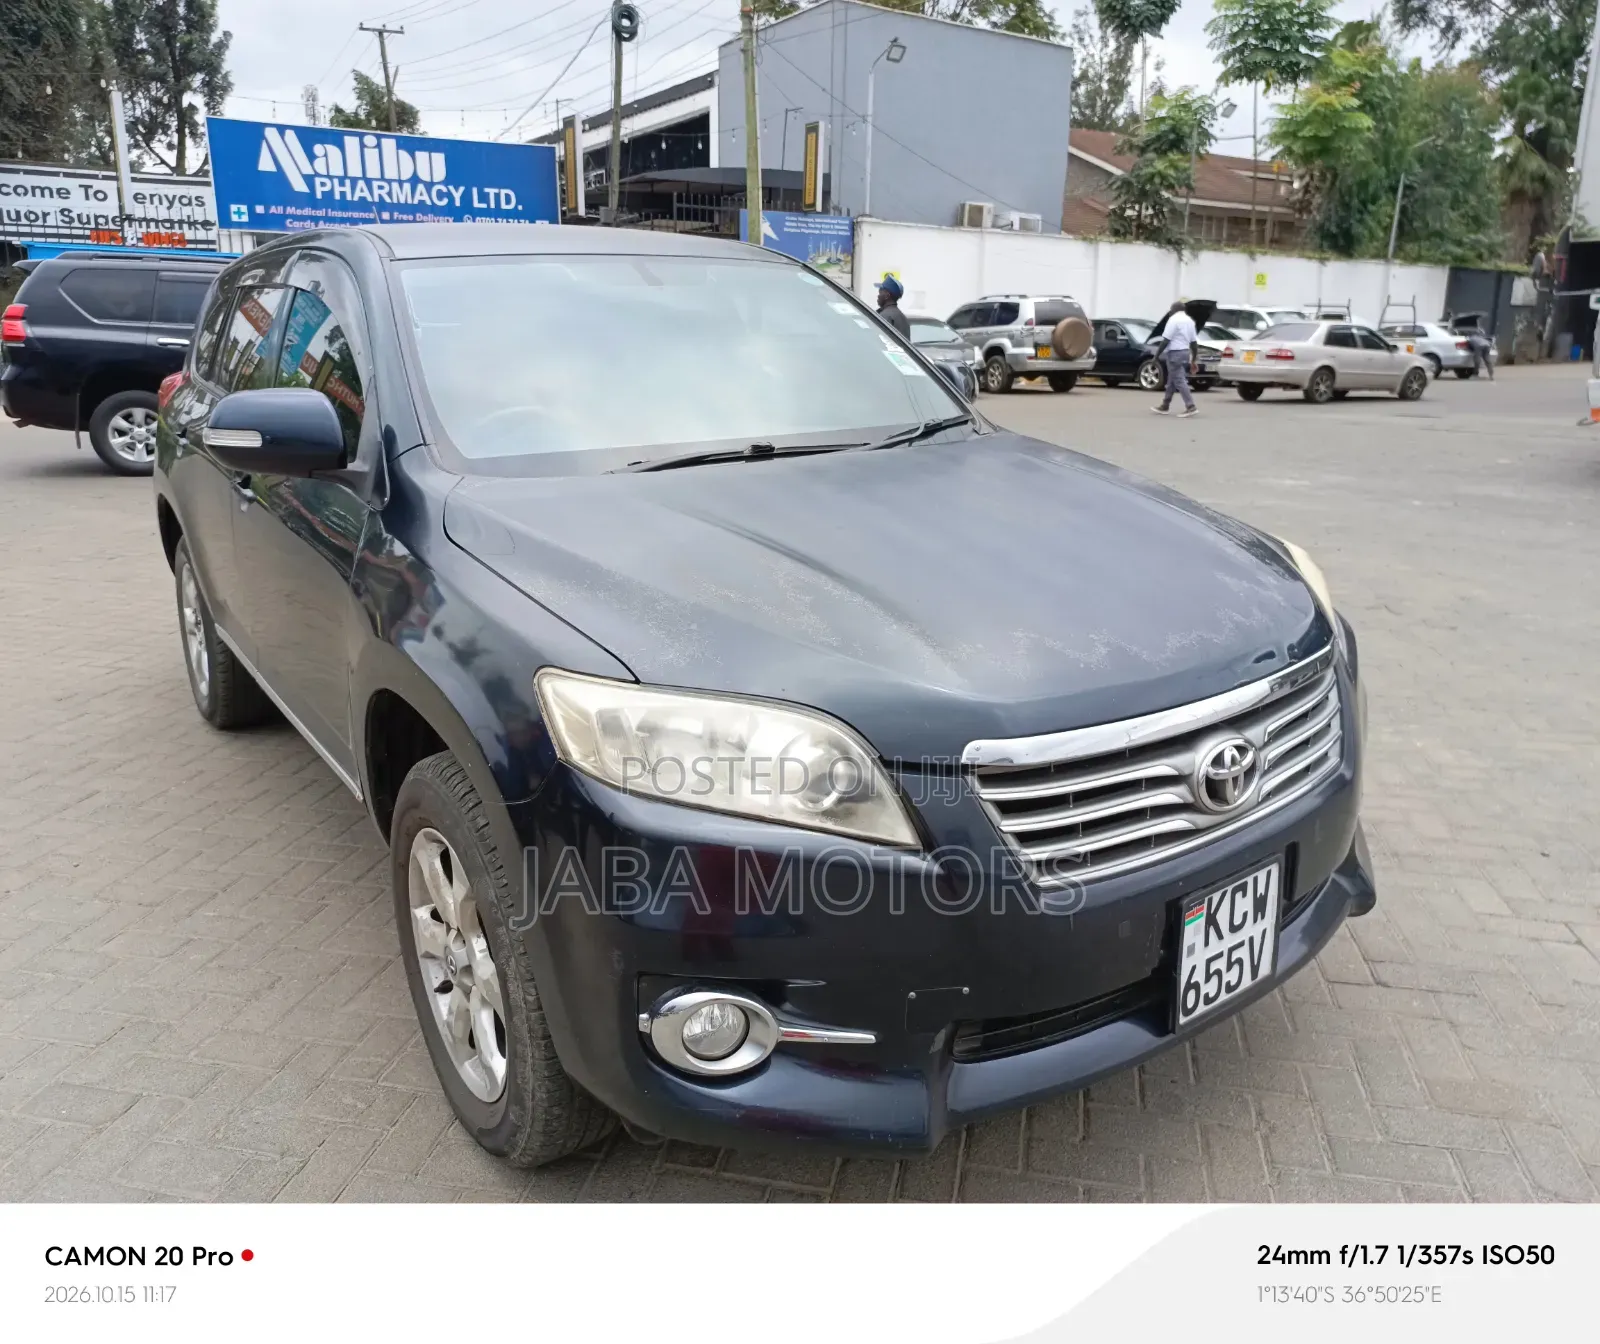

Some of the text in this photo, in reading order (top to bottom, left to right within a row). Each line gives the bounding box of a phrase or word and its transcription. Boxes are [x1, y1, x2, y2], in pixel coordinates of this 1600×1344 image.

[258, 127, 446, 193] Malibu
[79, 184, 108, 202] To
[132, 192, 206, 210] enyas
[314, 176, 523, 210] PHARMACY LTD.
[59, 207, 216, 231] Supermarke
[269, 205, 375, 219] All Medical Insurance
[285, 218, 316, 229] Cards
[393, 212, 413, 221] Free
[416, 213, 454, 224] Delivery
[1204, 868, 1272, 948] KCW
[1181, 927, 1267, 1018] 655V
